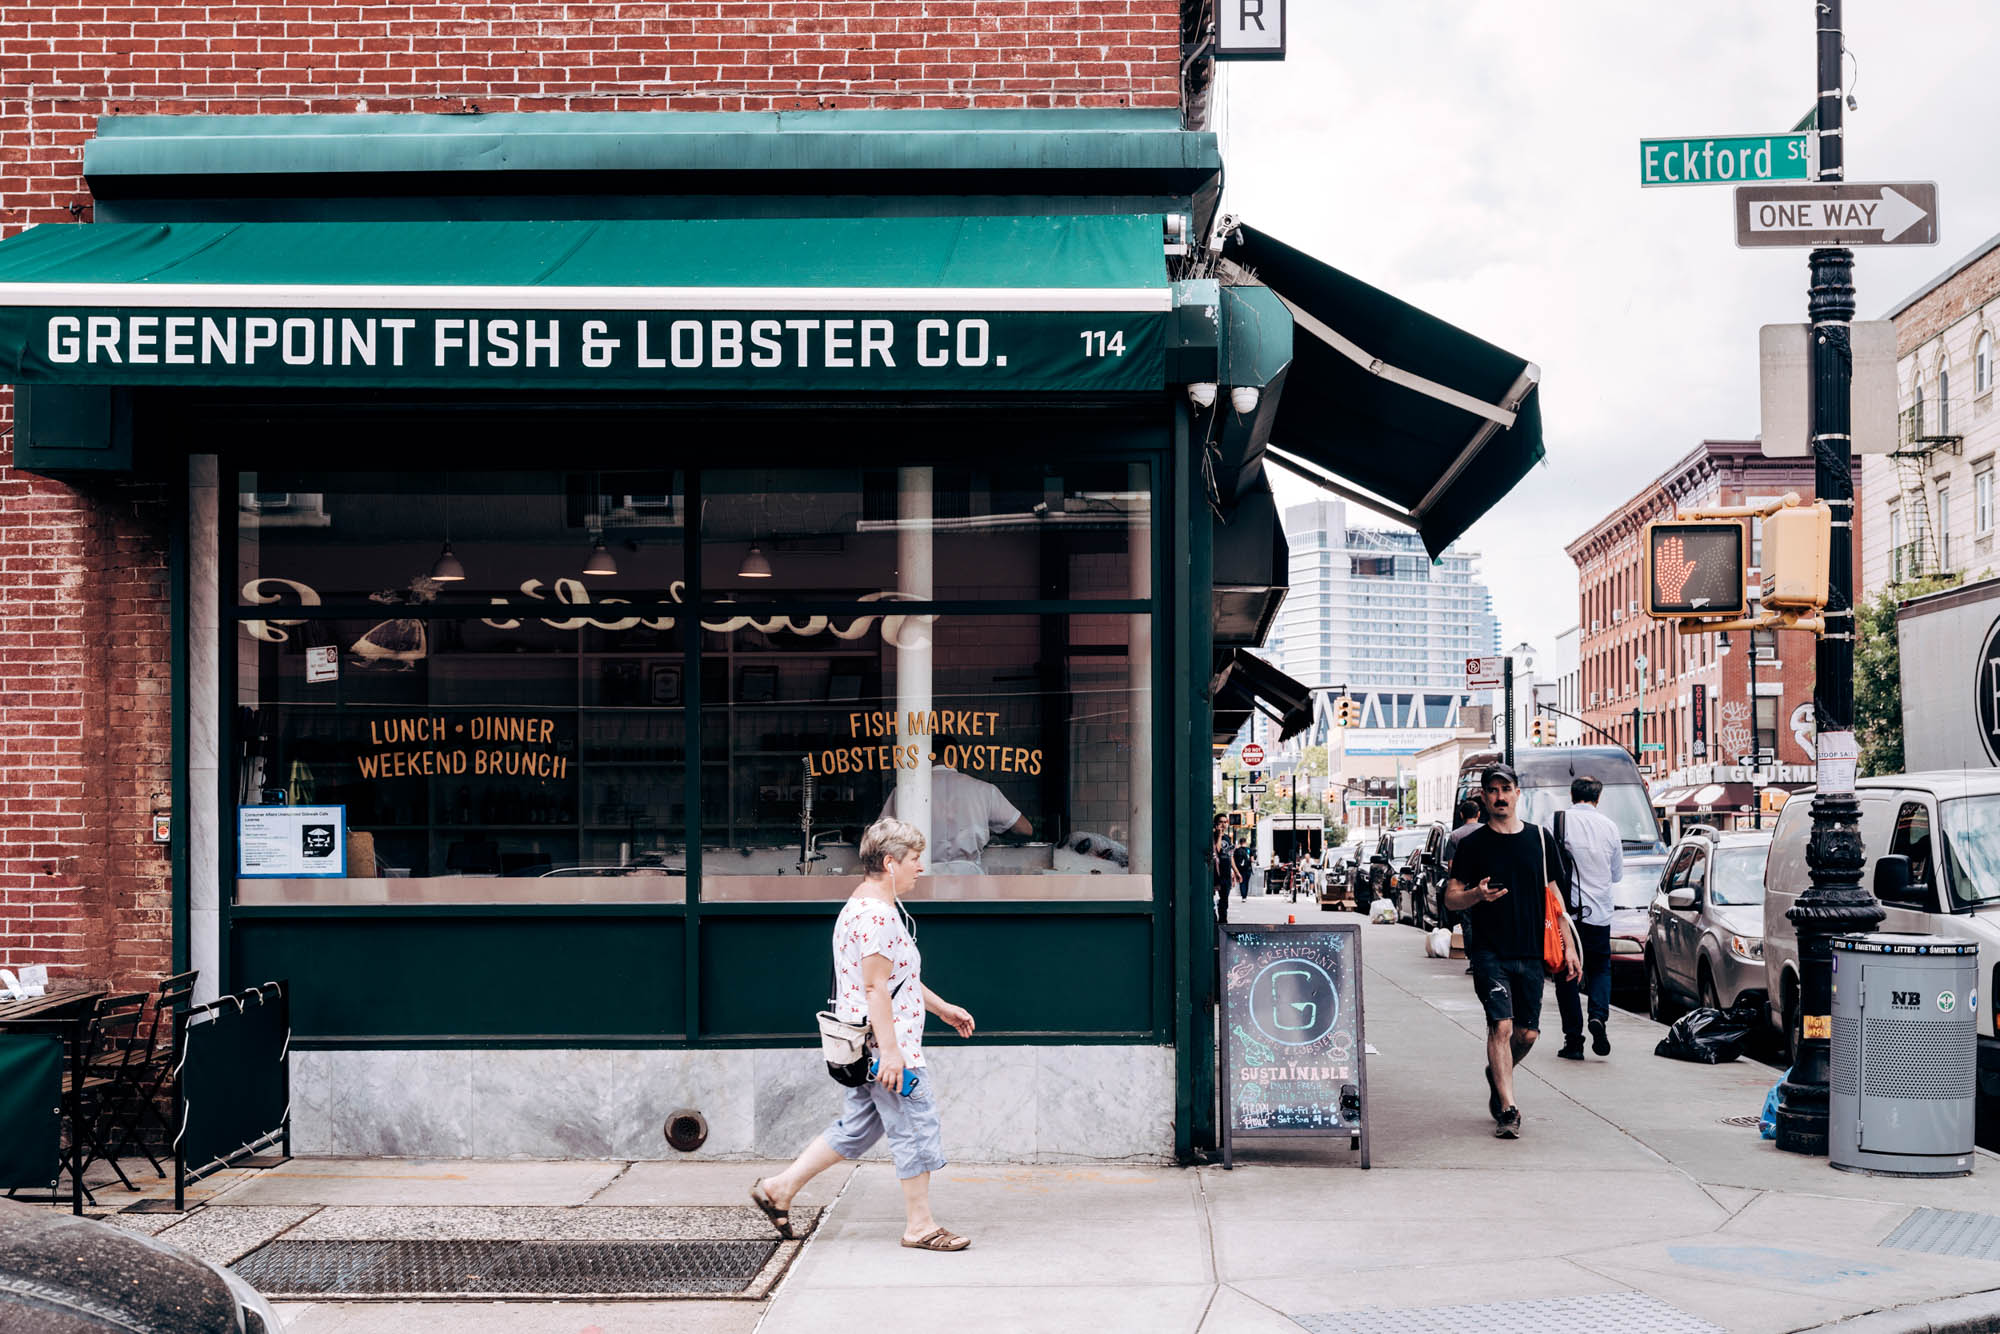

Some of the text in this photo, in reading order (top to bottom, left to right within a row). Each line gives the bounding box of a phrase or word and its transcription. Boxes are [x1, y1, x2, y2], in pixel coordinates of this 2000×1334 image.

[1240, 0, 1265, 31] R
[1645, 139, 1808, 182] Eckford St
[1759, 203, 1877, 227] ONE WAY
[48, 316, 1007, 368] GREENPOINT FISH & LOBSTER CO.
[1080, 330, 1126, 357] 114
[371, 716, 554, 745] LUNCH DINNER
[849, 710, 1000, 738] FISH MARKET
[357, 749, 567, 779] WEEKEND BRUNCH
[808, 743, 1043, 777] LOBSTERS OYSTERS
[1697, 804, 1712, 812] ATM
[1891, 992, 1921, 1006] NB
[1240, 1063, 1350, 1082] SUSTAINABLE
